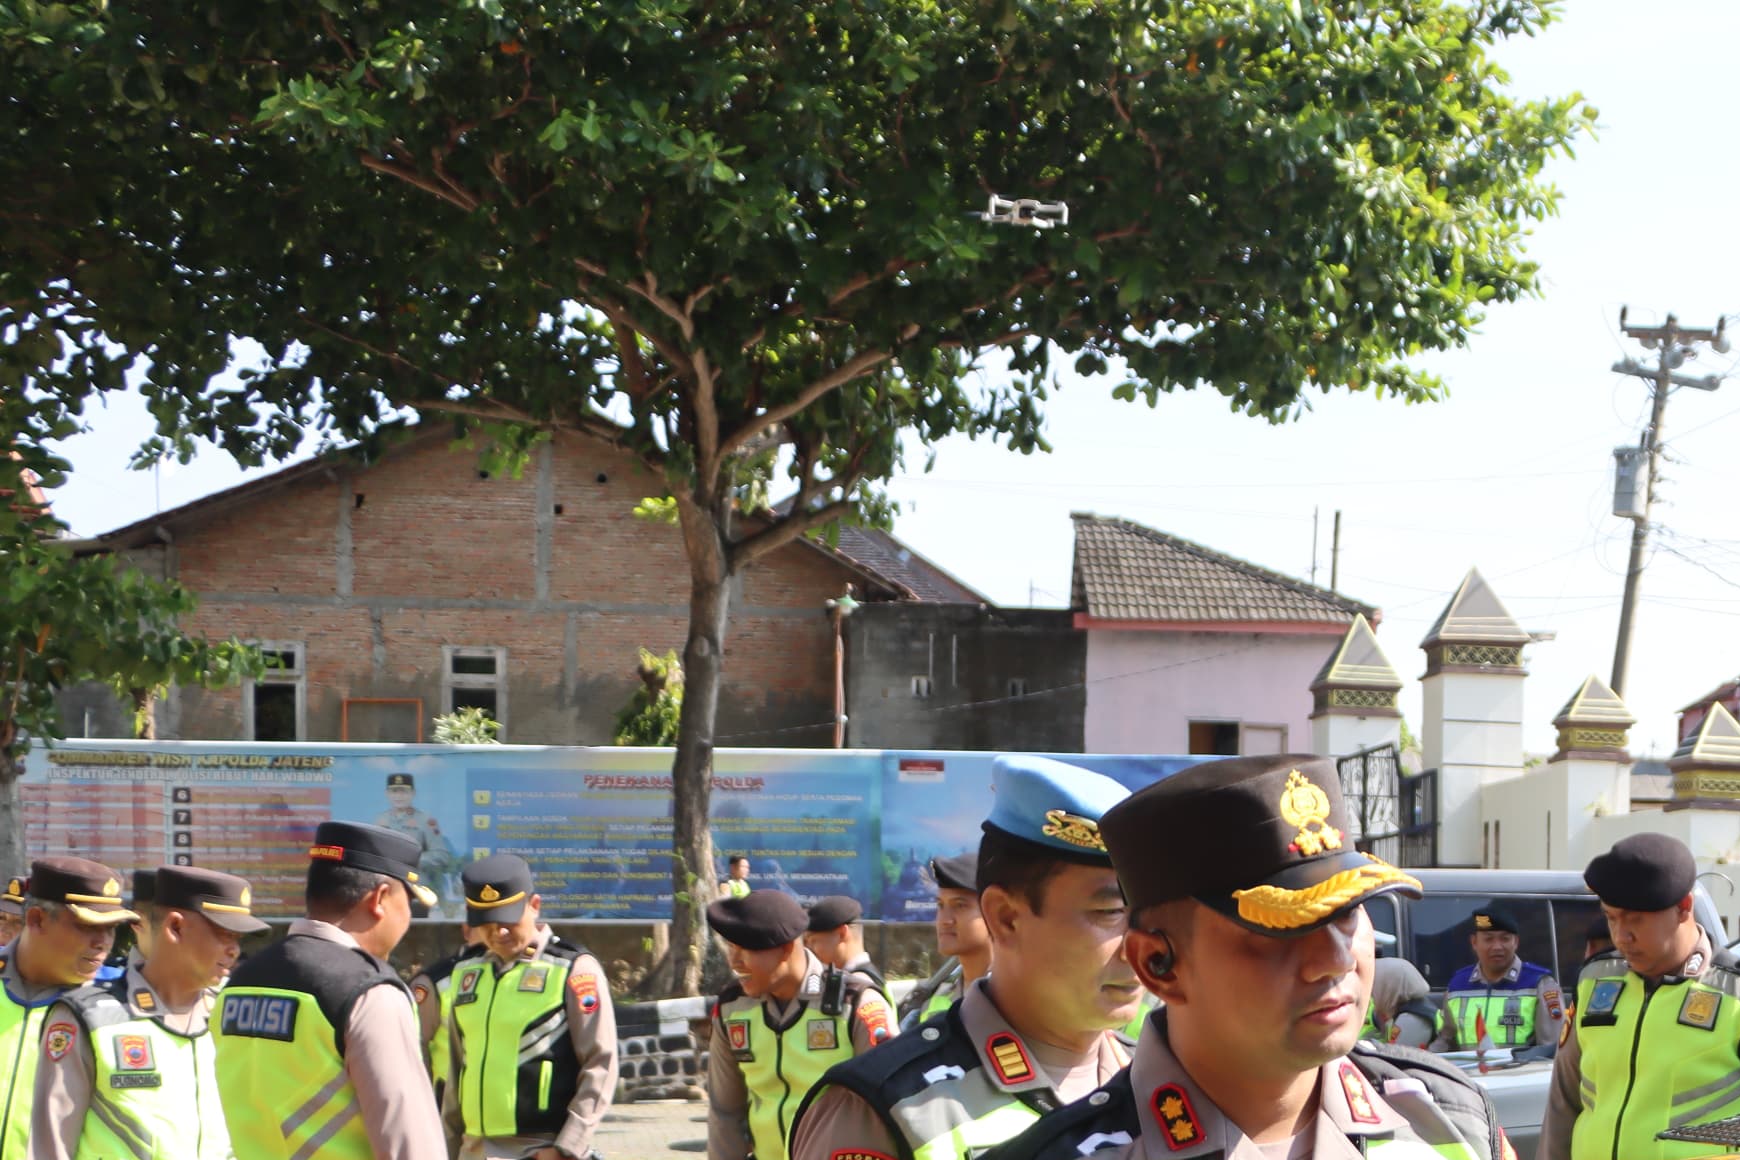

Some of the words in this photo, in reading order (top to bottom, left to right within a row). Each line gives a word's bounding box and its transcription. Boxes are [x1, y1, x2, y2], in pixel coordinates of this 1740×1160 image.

[152, 752, 192, 767] WISH
[197, 754, 269, 768] KAPOLDA
[272, 755, 336, 768] JATENG
[583, 774, 674, 789] PENEKANA
